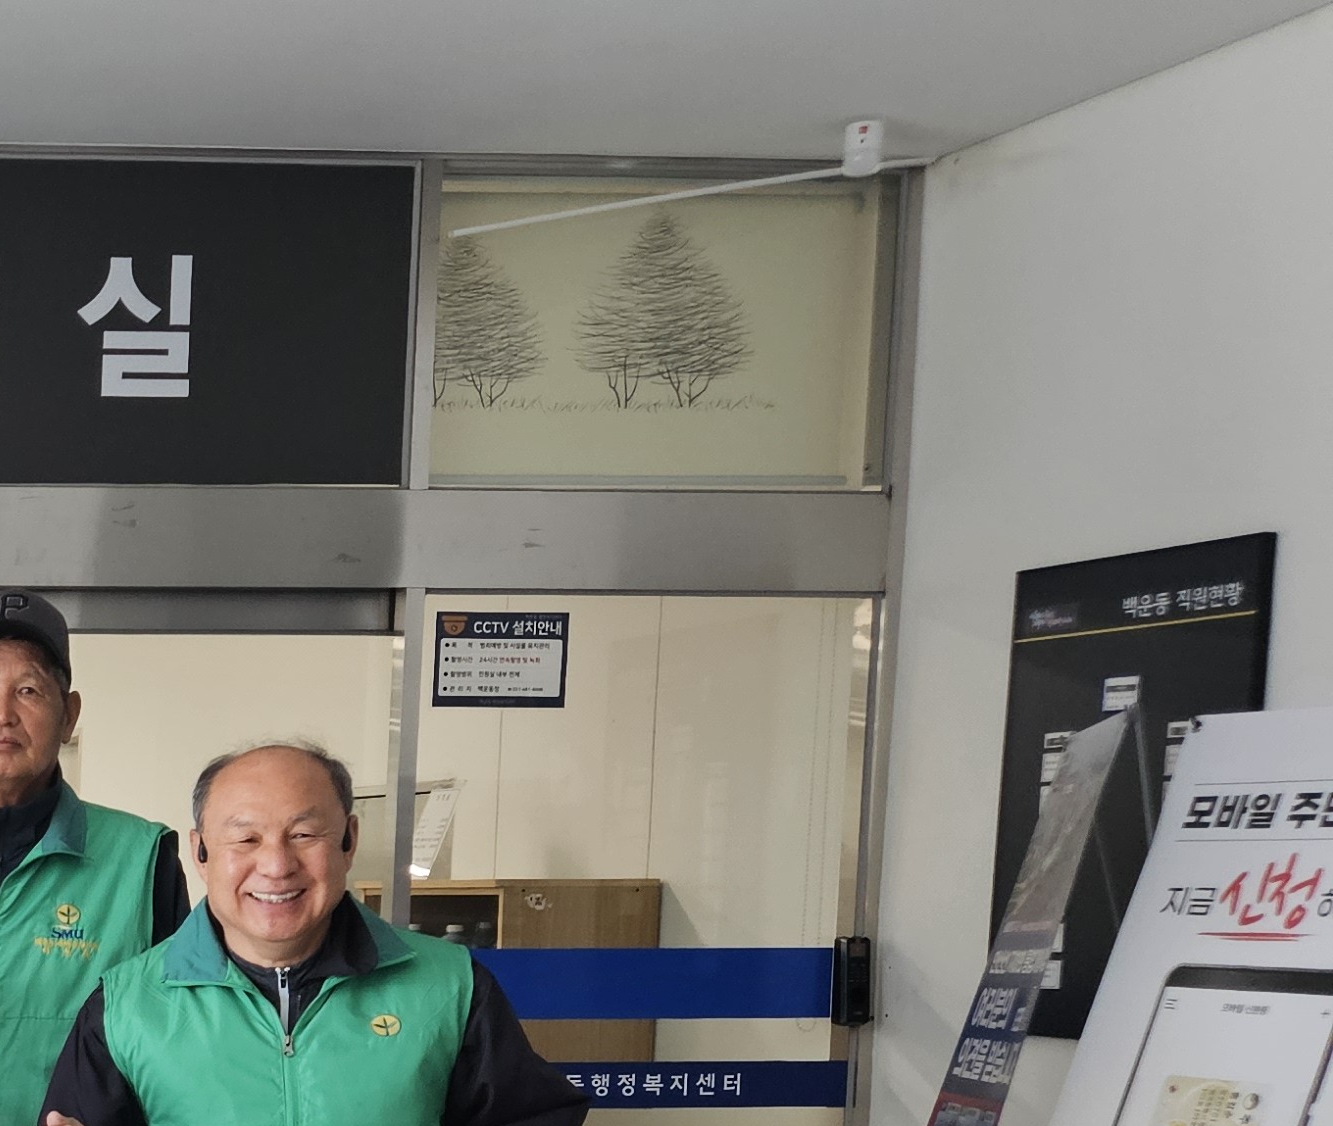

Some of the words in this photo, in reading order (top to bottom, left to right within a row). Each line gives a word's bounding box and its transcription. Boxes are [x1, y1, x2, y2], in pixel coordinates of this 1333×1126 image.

[1122, 591, 1171, 618] 백운동
[1176, 581, 1245, 611] 직원현황
[473, 621, 510, 634] CCTV
[512, 620, 563, 636] 설치안내
[1182, 793, 1283, 829] 모바일
[1160, 887, 1219, 916] 지금
[51, 927, 84, 940] SMU
